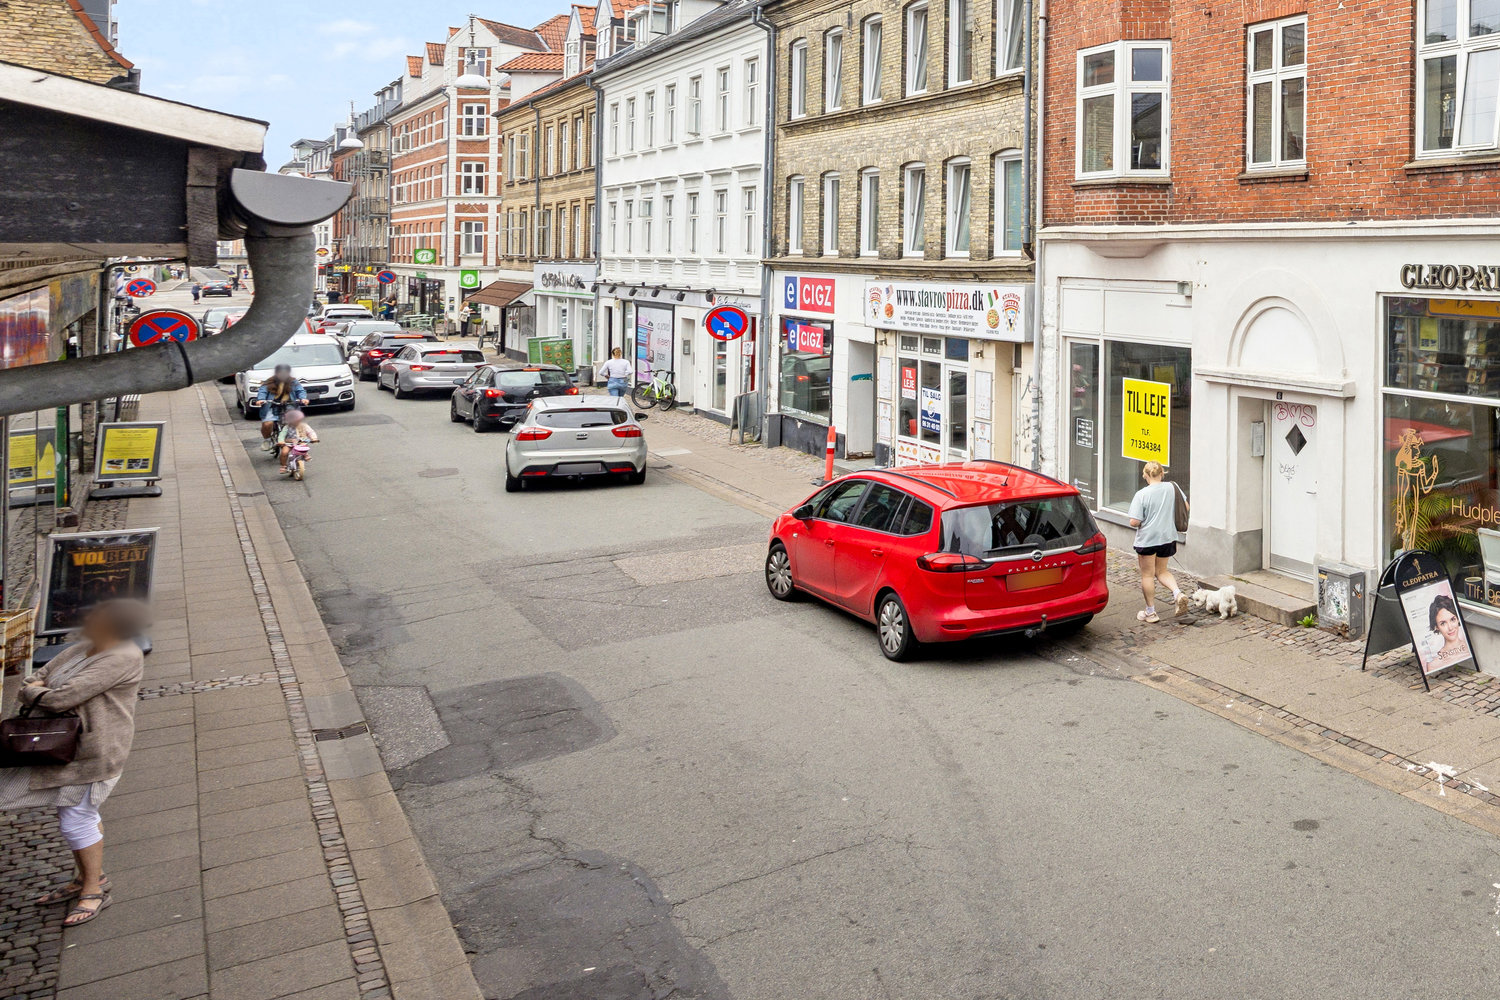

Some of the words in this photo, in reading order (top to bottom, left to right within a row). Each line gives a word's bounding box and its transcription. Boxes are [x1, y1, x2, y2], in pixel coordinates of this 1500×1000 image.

[787, 282, 795, 303] e
[802, 283, 832, 307] CIGZ
[896, 288, 984, 312] www.stavrospizza.dk
[789, 328, 796, 344] e
[800, 331, 822, 348] CIGZ
[1127, 390, 1142, 414] TIL
[1144, 392, 1167, 418] LEJE
[1130, 438, 1161, 453] 71334384
[71, 547, 148, 567] VOLBEAT
[1402, 570, 1439, 588] CLEOPATRA
[1465, 582, 1483, 600] Tlf:
